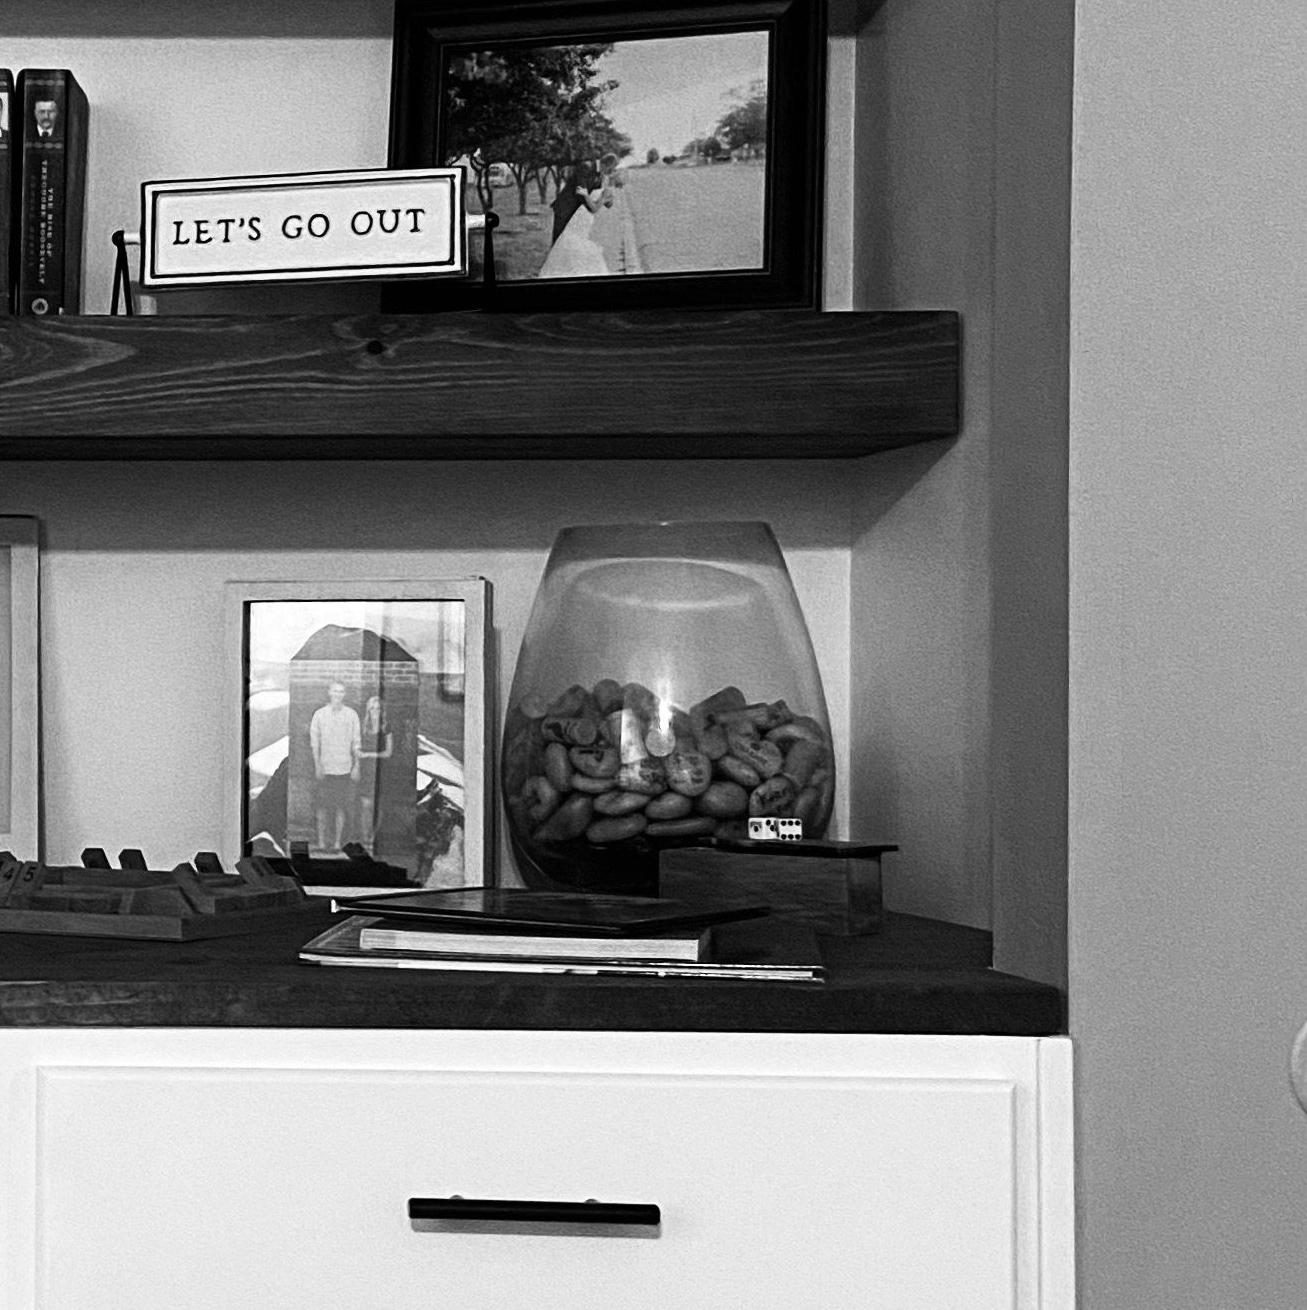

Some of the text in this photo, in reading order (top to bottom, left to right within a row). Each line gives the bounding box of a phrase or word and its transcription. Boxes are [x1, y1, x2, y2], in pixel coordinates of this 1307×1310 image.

[172, 208, 426, 245] LET'S GO OUT
[22, 866, 37, 882] 5
